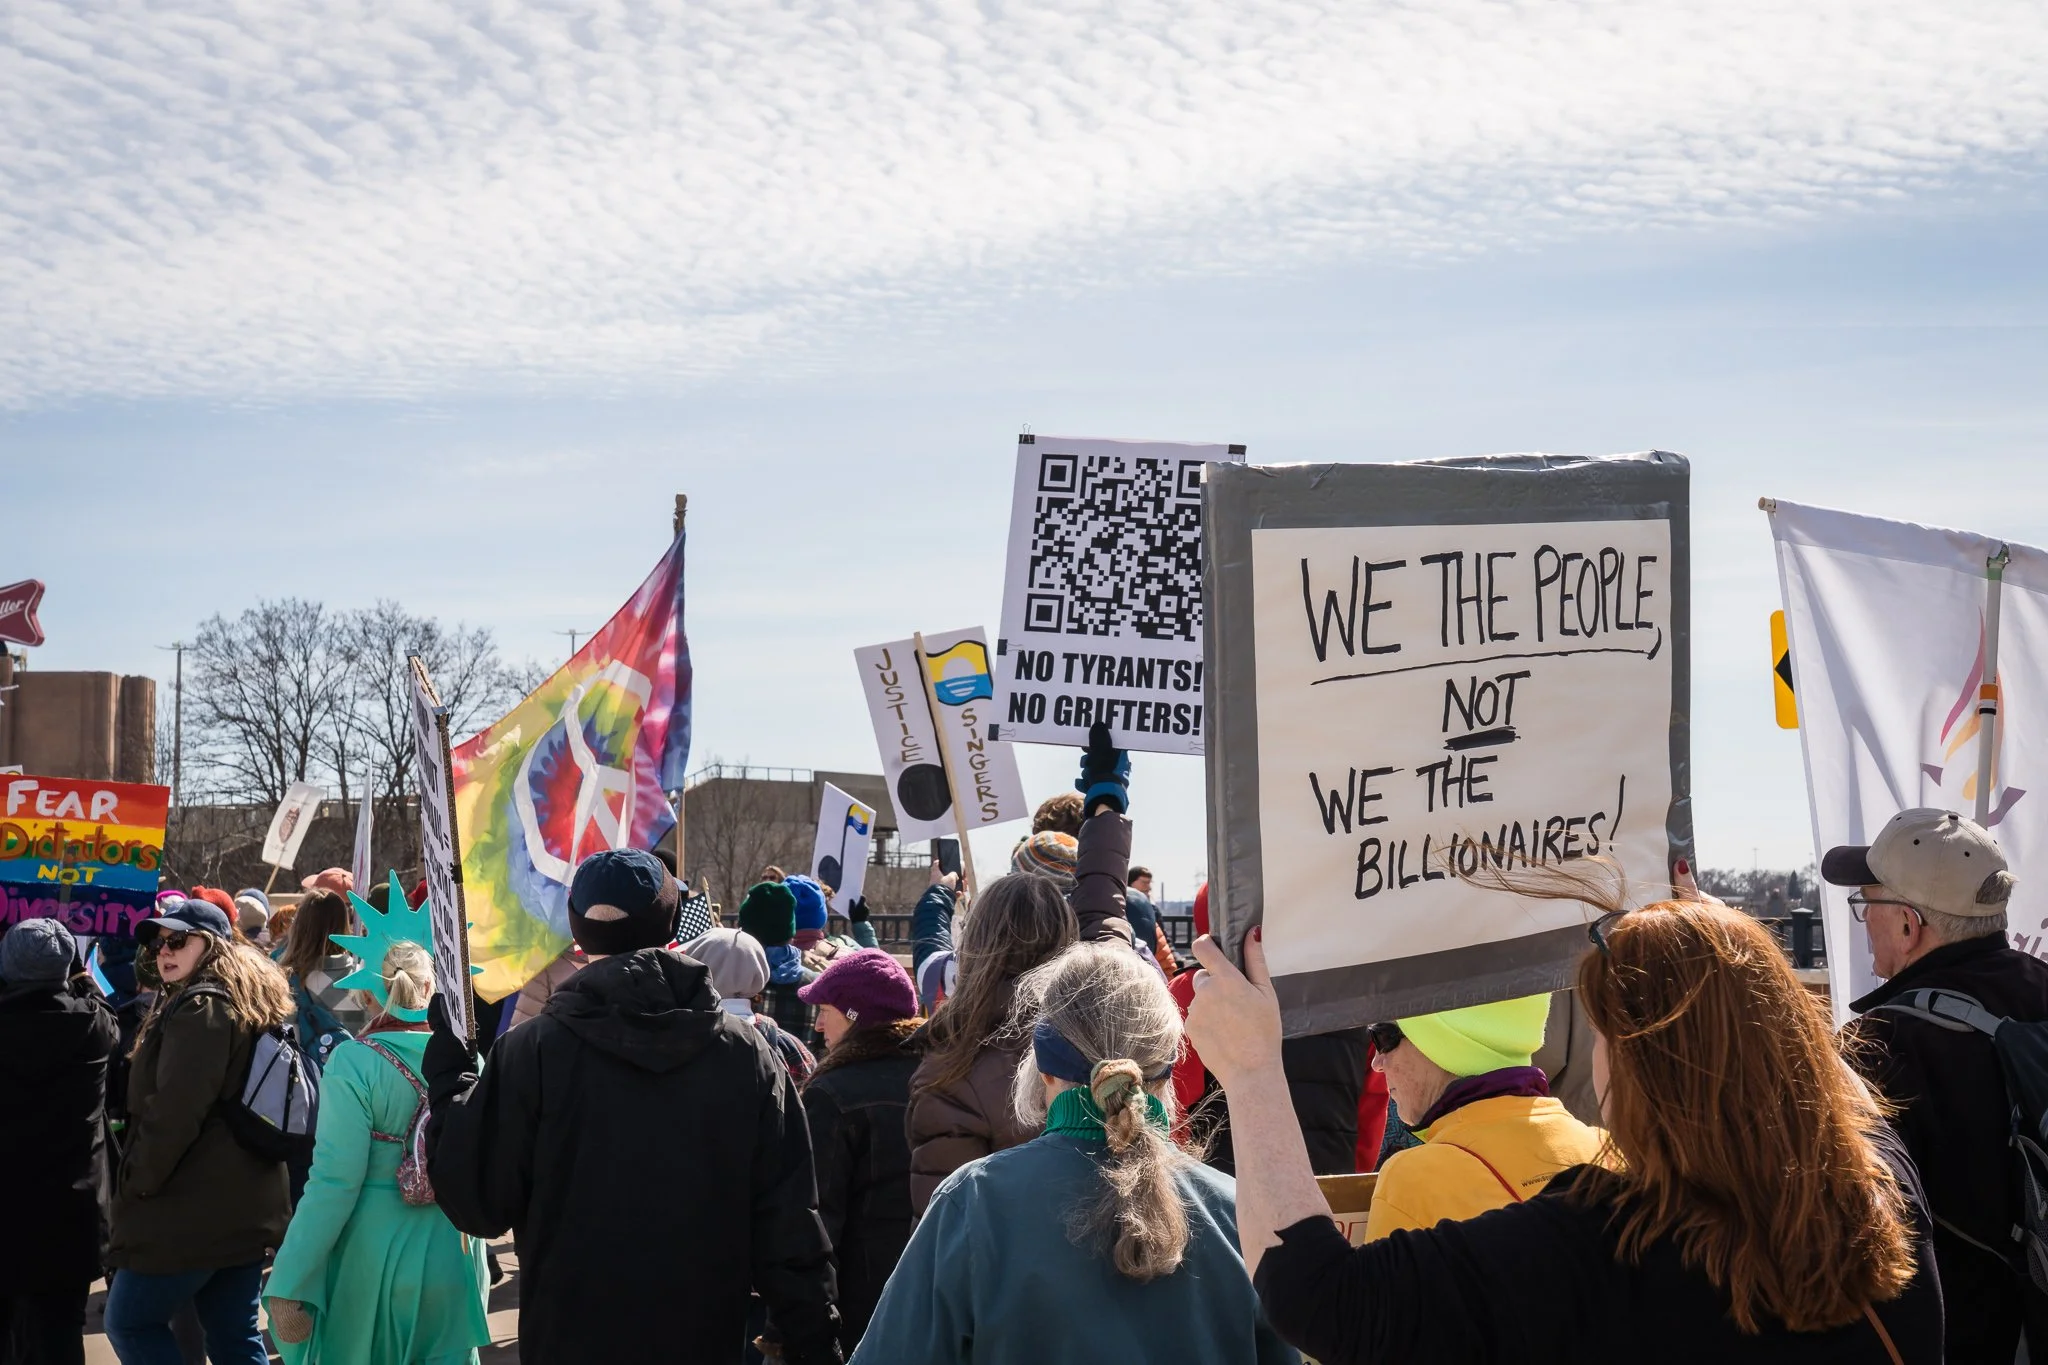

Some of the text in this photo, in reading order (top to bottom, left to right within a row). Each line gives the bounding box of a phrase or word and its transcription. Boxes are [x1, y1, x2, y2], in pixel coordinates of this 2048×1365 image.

[1300, 544, 1662, 662] WE THE PEOPLE,
[1015, 650, 1203, 692] NO TYRANTS!
[1442, 670, 1531, 733] NOT
[875, 648, 924, 763] JUSTICE
[1008, 692, 1203, 736] NO GRIFTERS!
[961, 708, 999, 823] SINGERS
[1309, 755, 1498, 834] WE THE
[7, 780, 120, 825] FEAR
[0, 822, 160, 872] Dictators
[1354, 774, 1626, 900] BILLIONAIRES!
[37, 864, 104, 885] NOT
